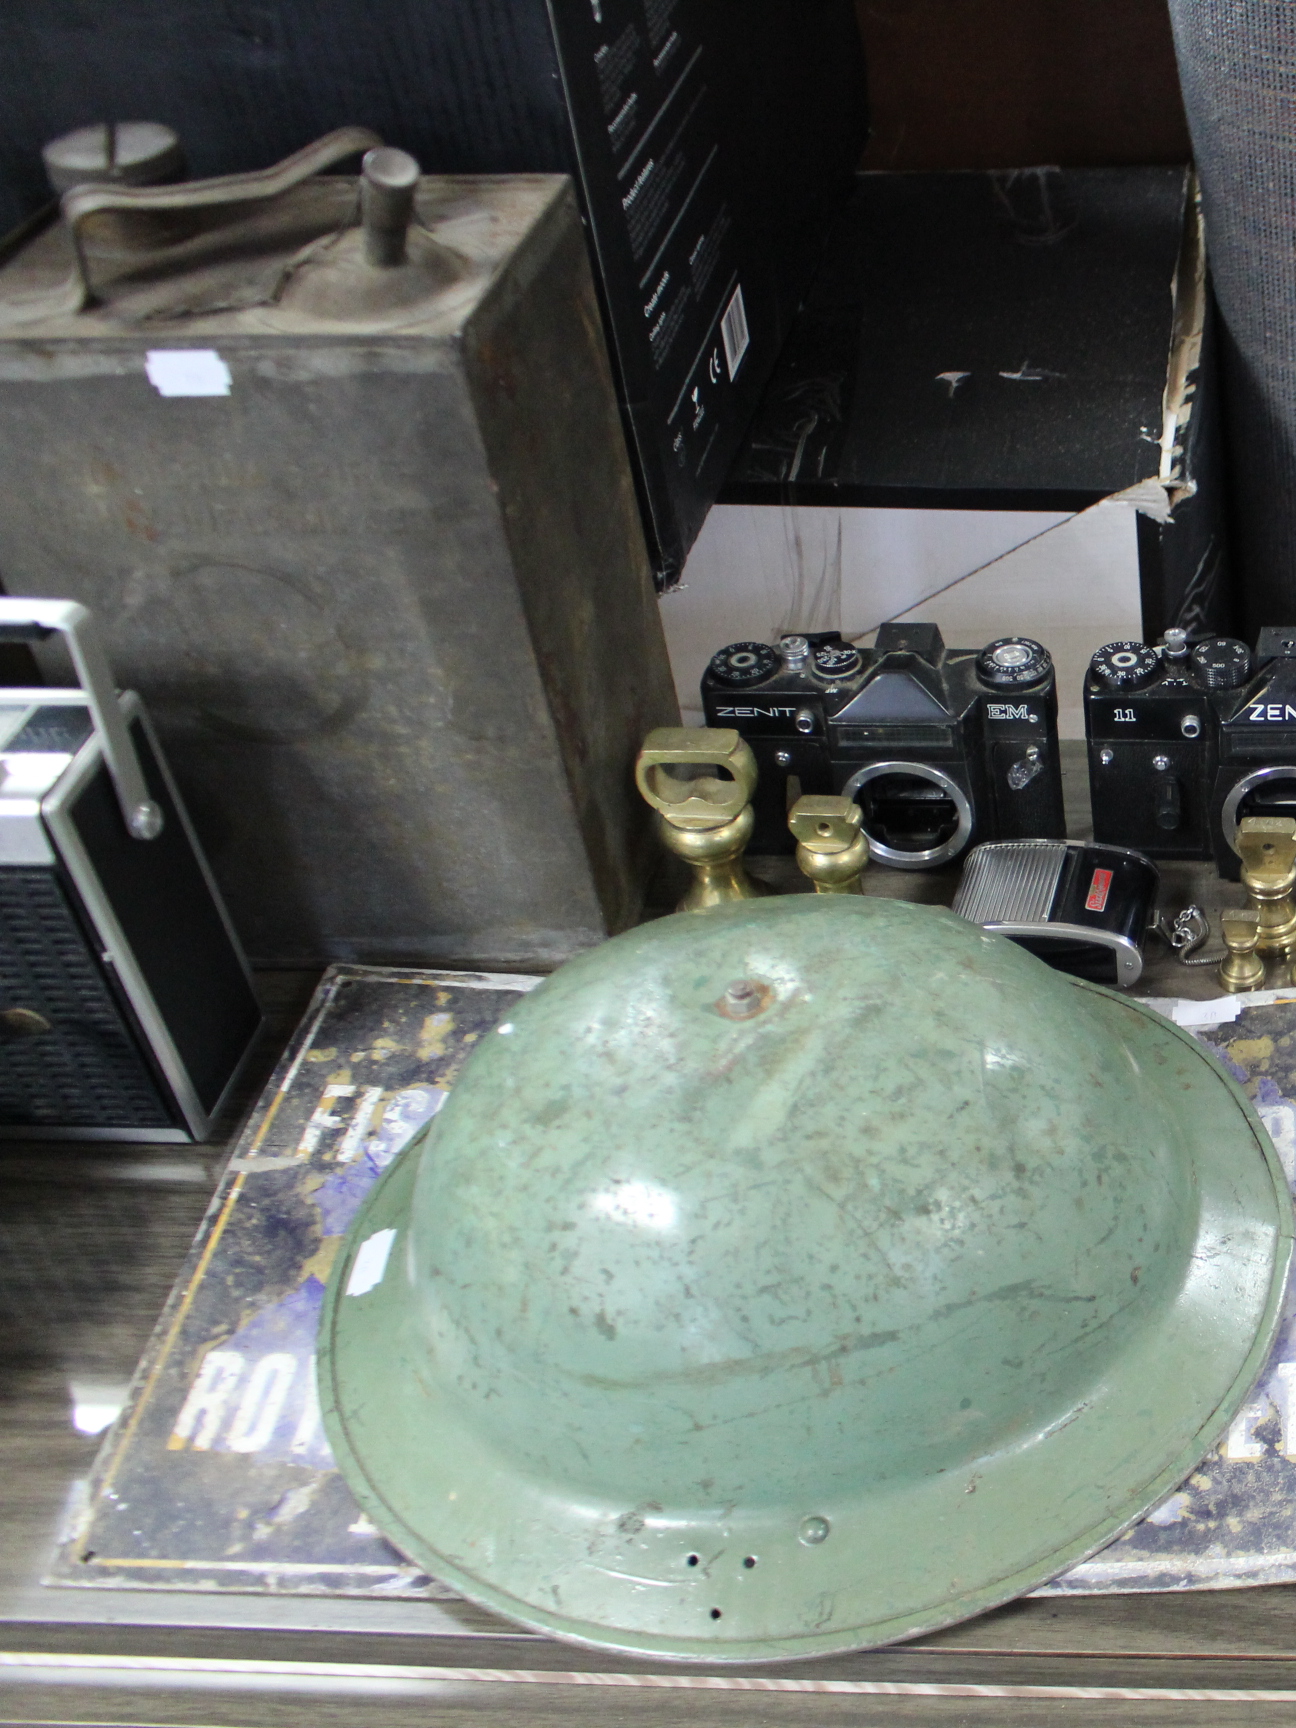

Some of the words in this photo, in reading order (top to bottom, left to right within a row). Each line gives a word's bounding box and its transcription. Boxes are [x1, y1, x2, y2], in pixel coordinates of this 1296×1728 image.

[716, 706, 797, 717] ZENIT
[987, 704, 1029, 720] EM
[1113, 708, 1137, 722] 11
